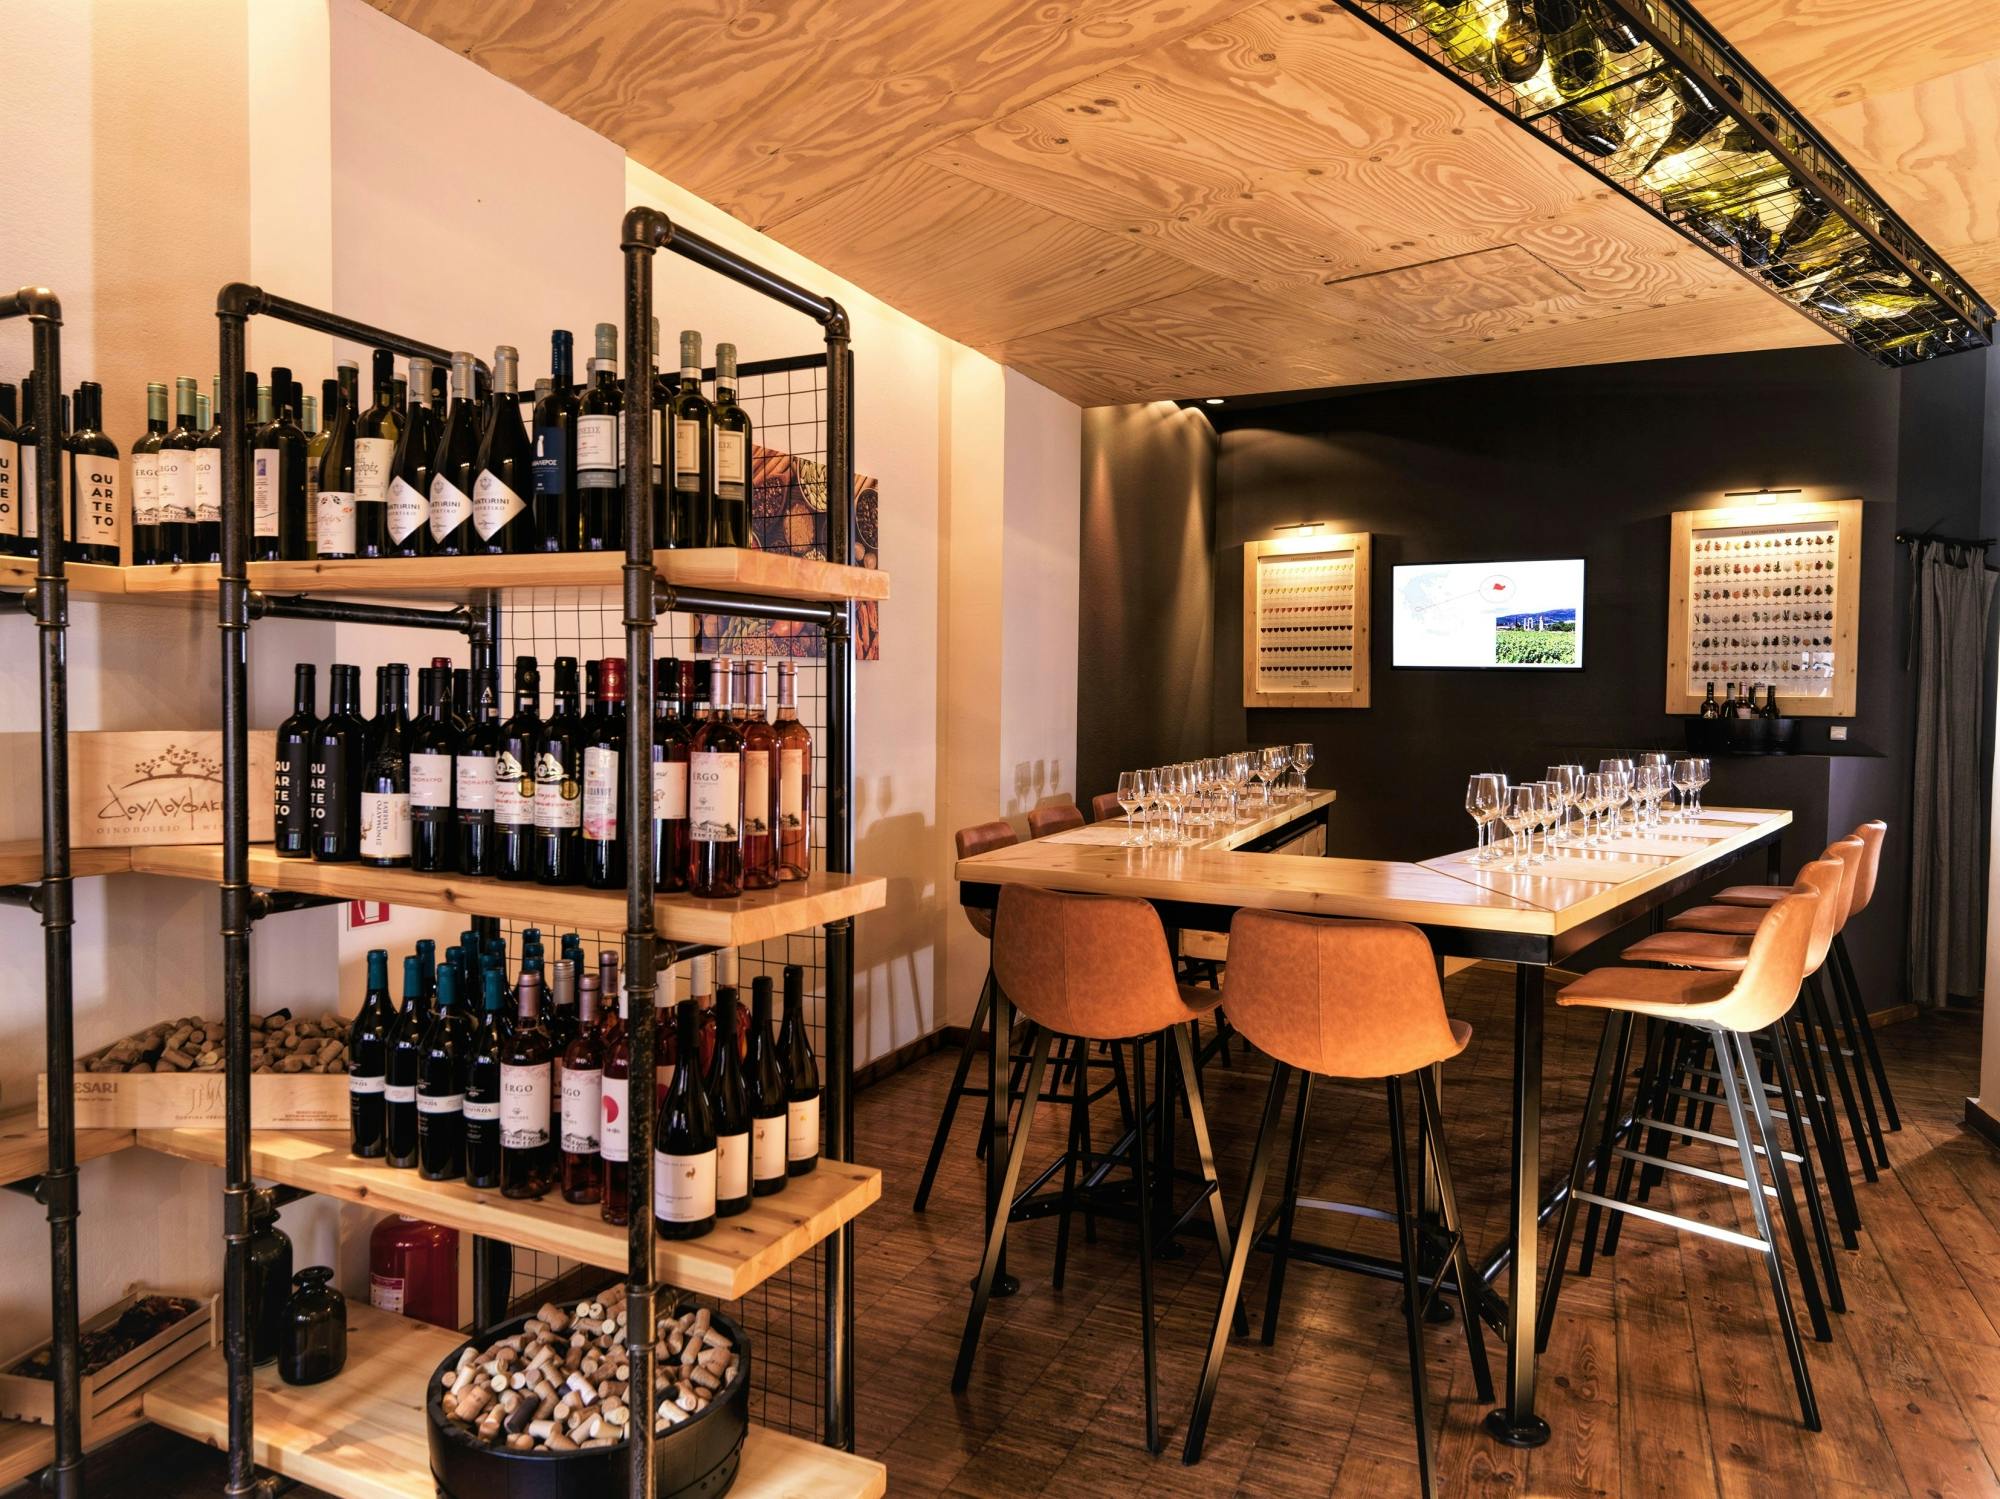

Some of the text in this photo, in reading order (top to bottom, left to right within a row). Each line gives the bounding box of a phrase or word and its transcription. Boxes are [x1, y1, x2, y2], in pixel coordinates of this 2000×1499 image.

[90, 473, 113, 485] QU
[91, 487, 113, 499] AR
[92, 501, 113, 513] TE
[92, 515, 114, 527] TO
[692, 772, 719, 781] ERGO
[74, 1082, 118, 1094] ESARI
[504, 1082, 533, 1093] ERGO
